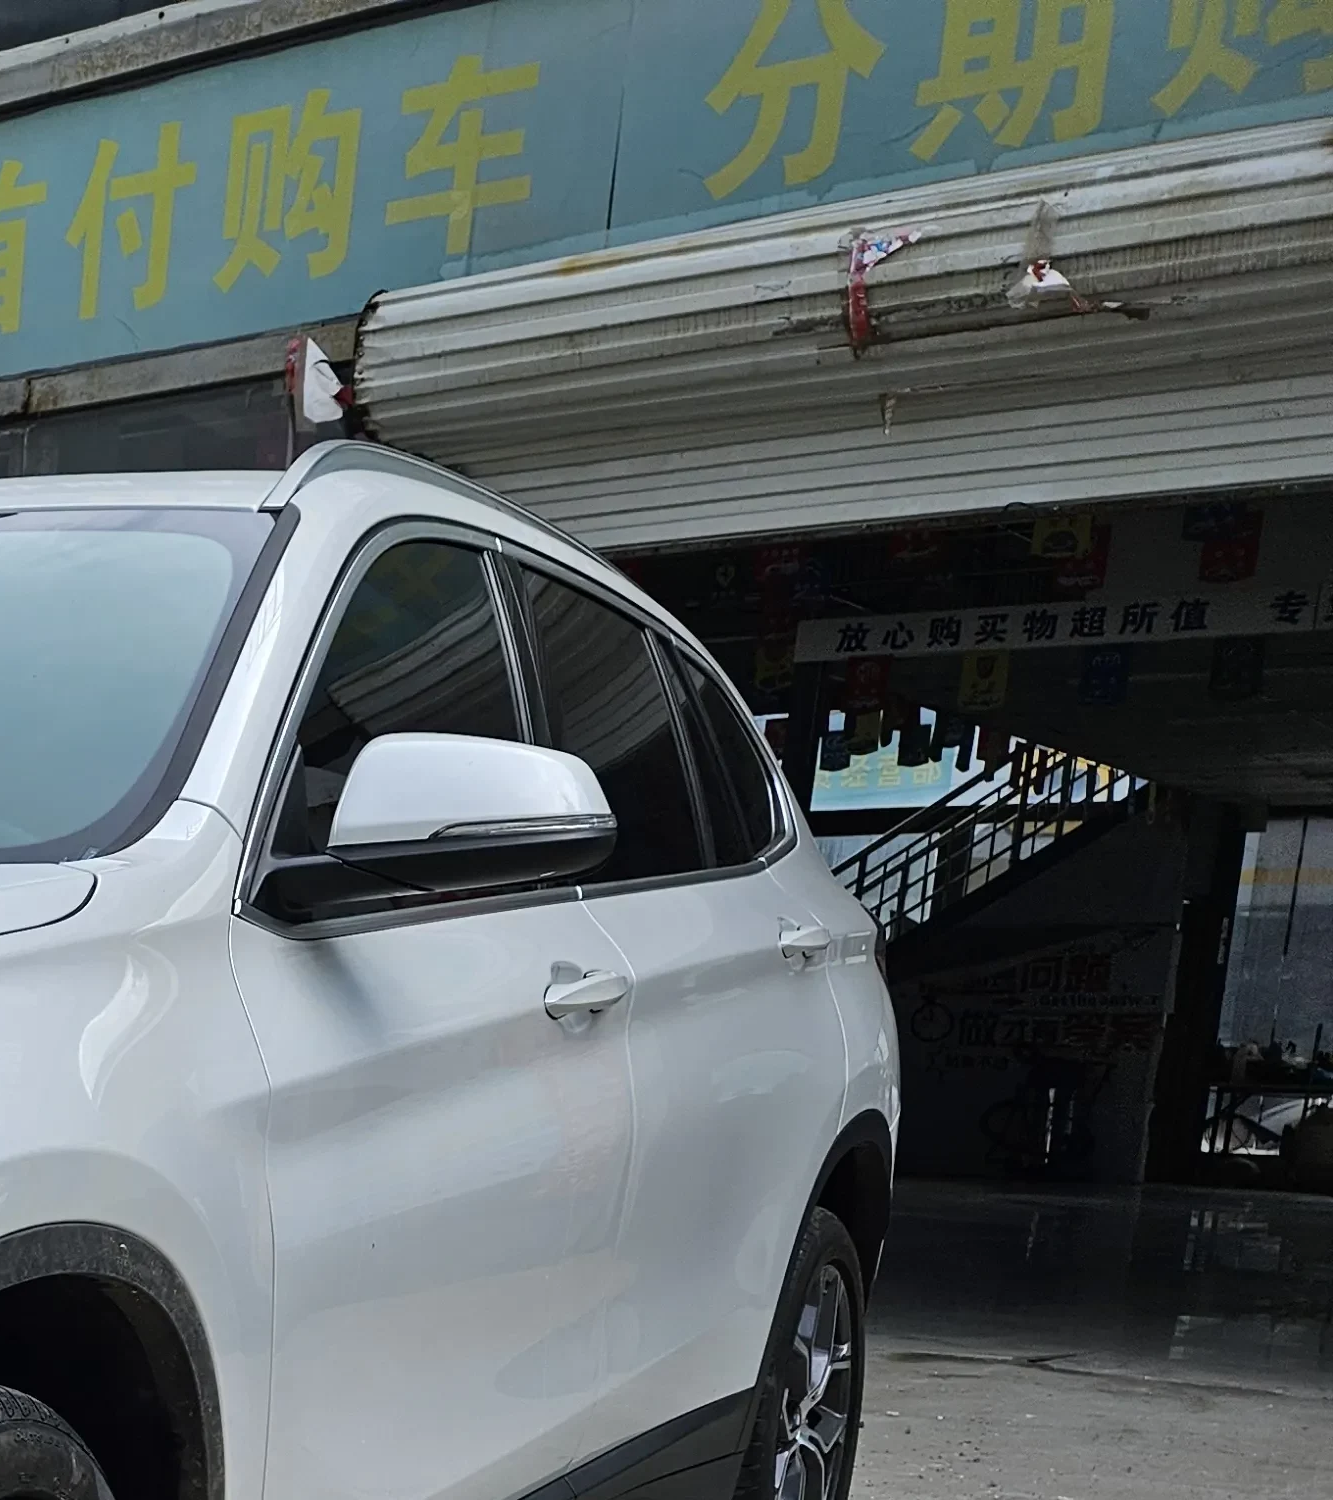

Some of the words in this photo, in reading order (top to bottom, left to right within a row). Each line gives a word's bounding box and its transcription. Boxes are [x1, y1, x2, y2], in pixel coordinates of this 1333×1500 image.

[834, 598, 1211, 654] 放心购买物超所值
